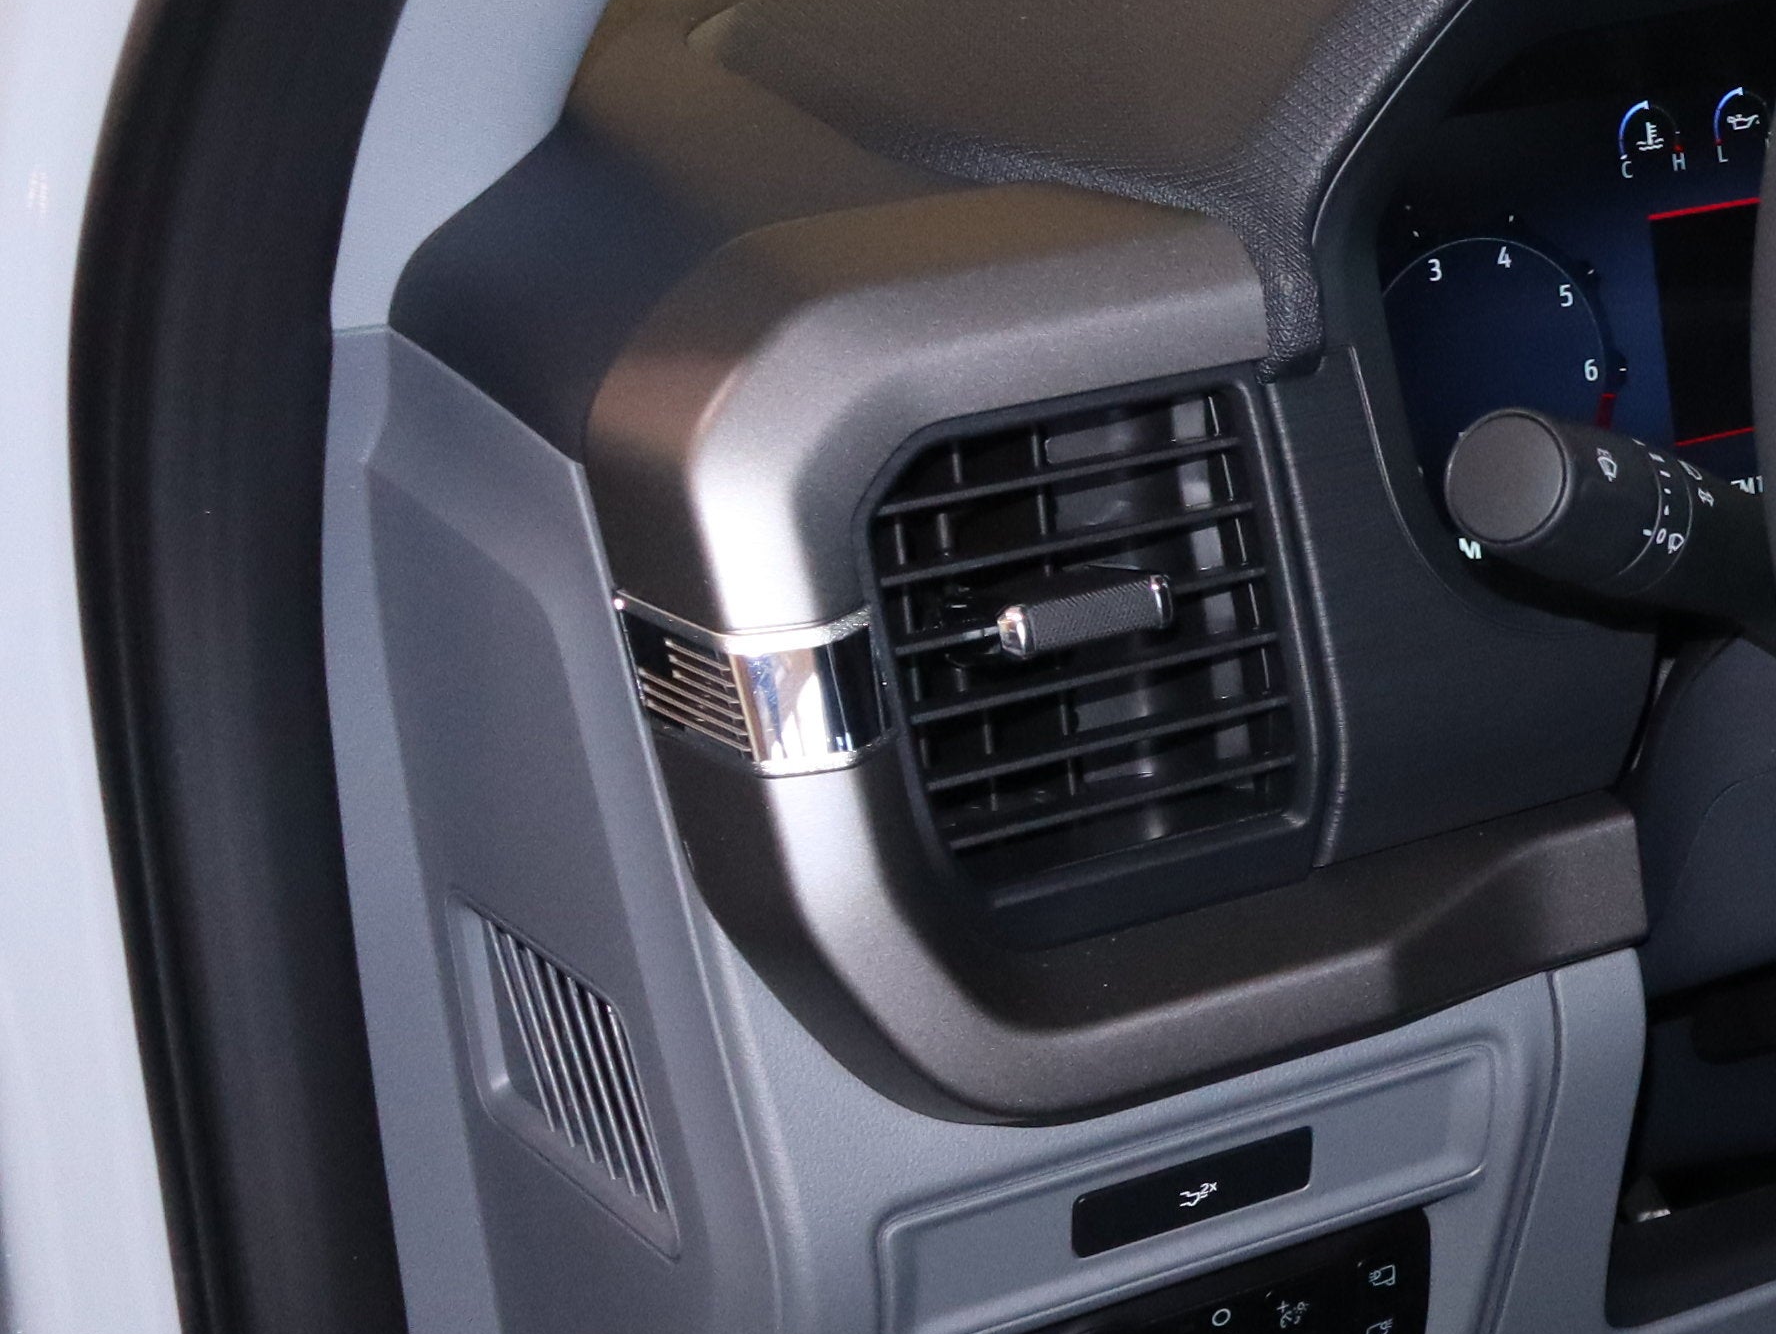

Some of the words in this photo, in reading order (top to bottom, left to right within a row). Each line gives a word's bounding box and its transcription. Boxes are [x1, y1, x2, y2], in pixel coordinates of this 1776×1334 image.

[1672, 152, 1686, 171] H
[1717, 145, 1728, 163] L
[1621, 161, 1633, 178] C
[1497, 246, 1512, 269] 4
[1427, 258, 1443, 282] 3
[1559, 284, 1574, 307] 5
[1584, 358, 1599, 382] 6
